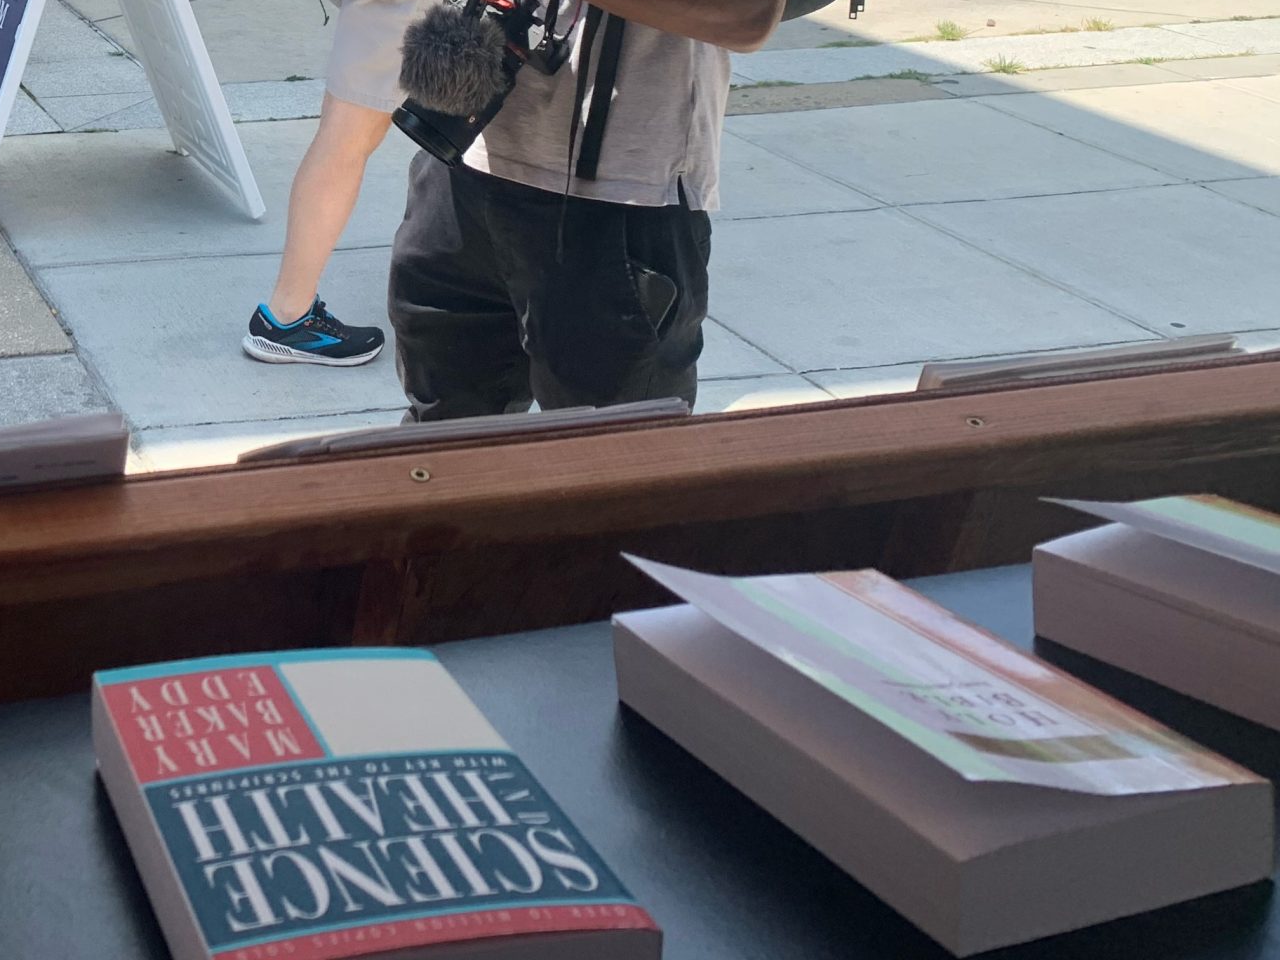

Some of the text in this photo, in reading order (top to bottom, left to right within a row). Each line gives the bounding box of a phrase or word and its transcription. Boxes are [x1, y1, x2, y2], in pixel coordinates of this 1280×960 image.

[128, 672, 267, 713] EDDY
[133, 698, 283, 742] BAKER
[153, 726, 302, 775] MARY
[170, 756, 507, 800] WITH KEY TO THE SCRIPTURES
[172, 769, 520, 863] HEALTH
[202, 826, 600, 932] SCIENCE
